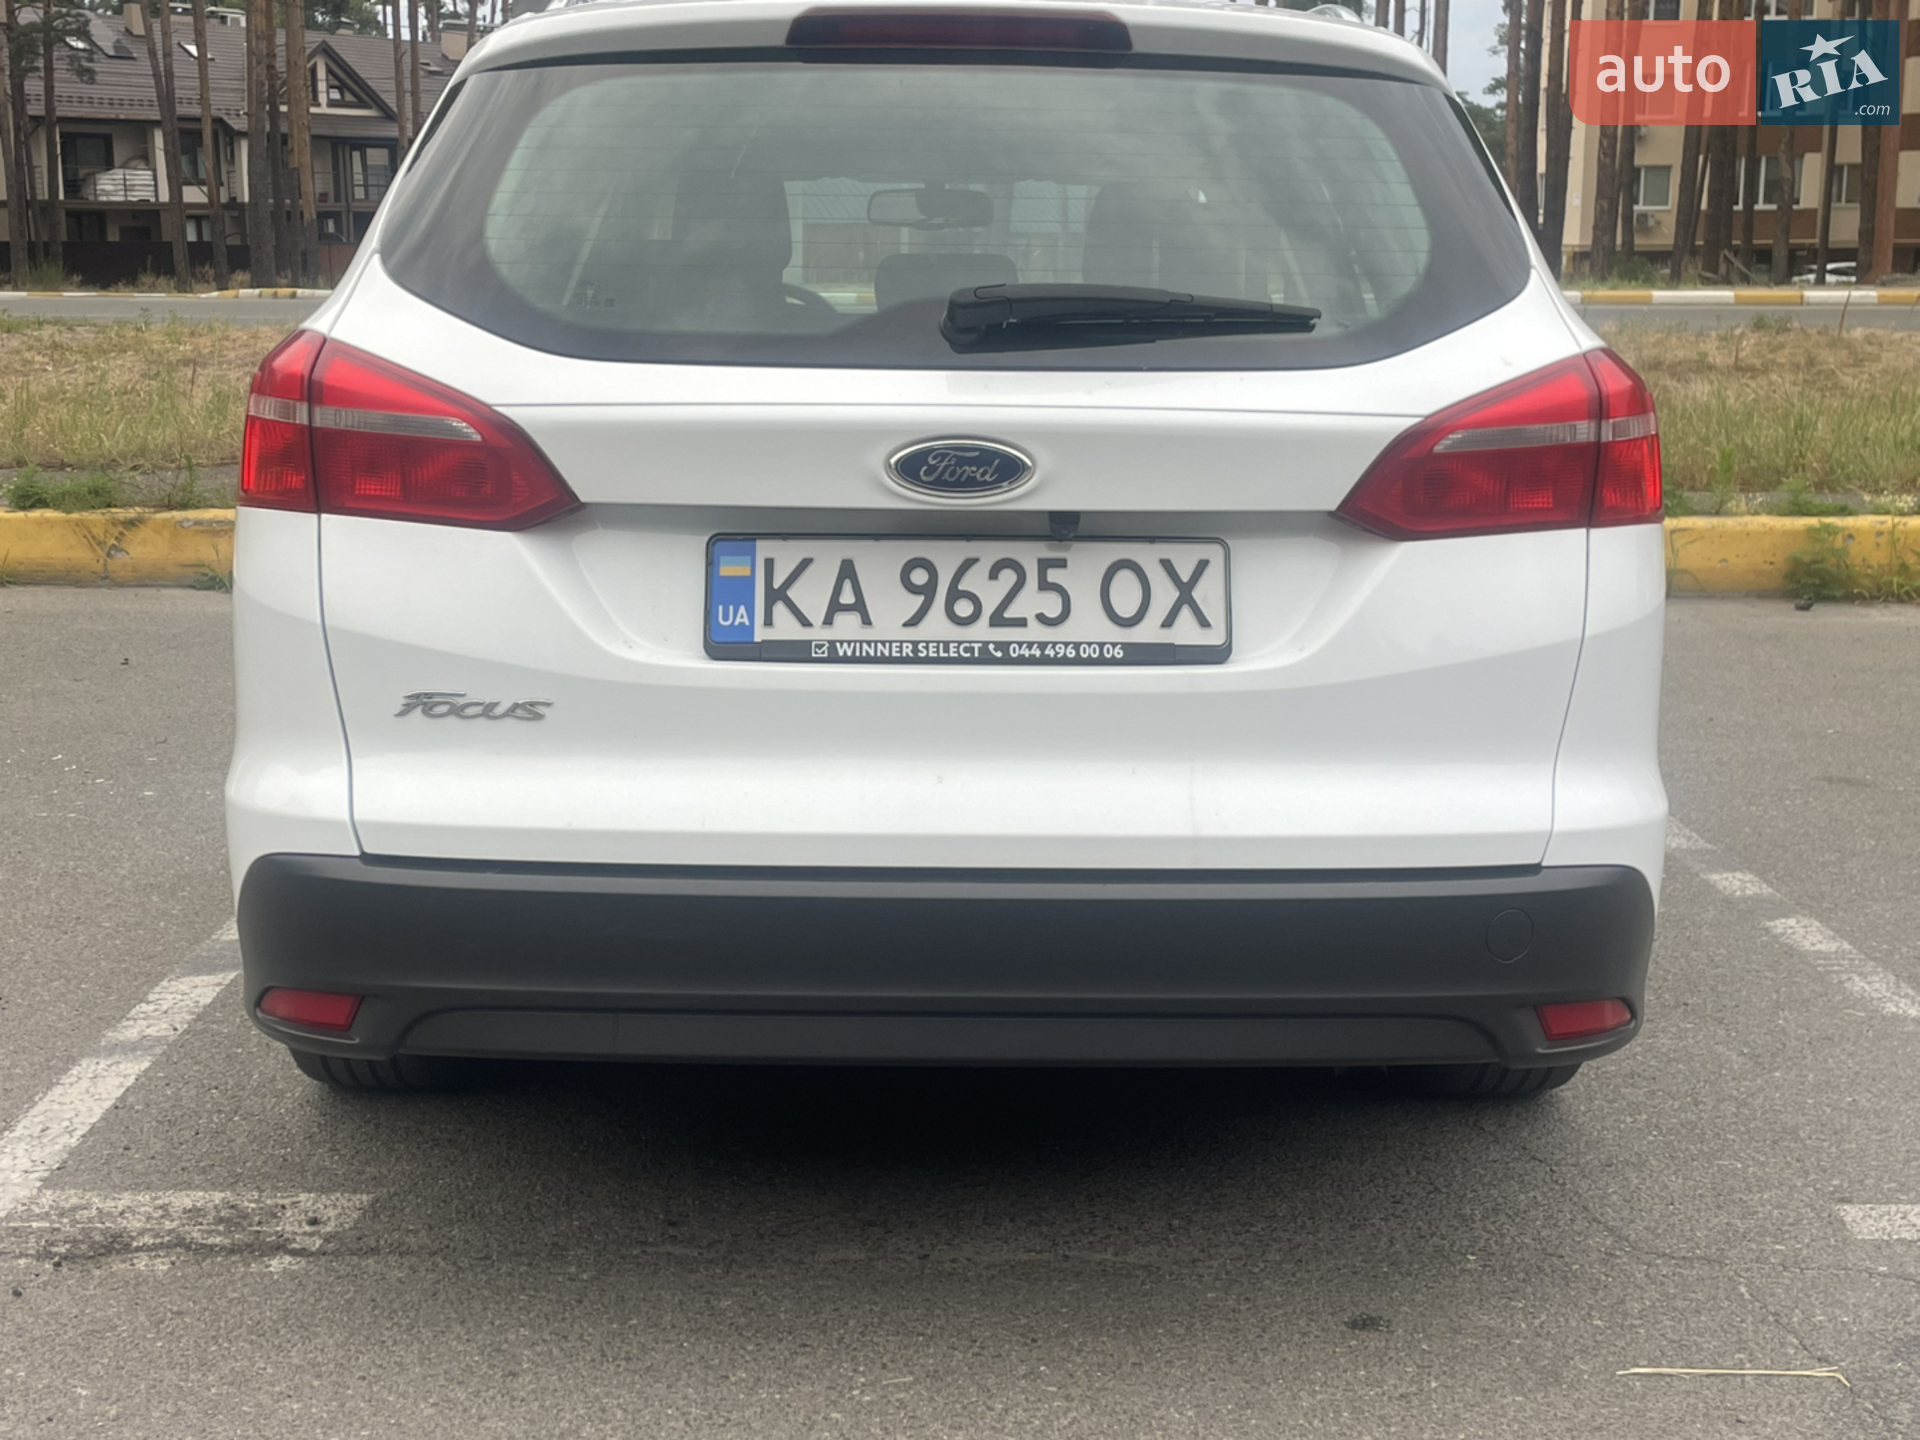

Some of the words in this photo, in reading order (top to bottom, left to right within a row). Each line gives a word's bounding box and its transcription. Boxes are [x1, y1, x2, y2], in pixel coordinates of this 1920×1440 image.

[919, 449, 1001, 482] Ford
[763, 557, 873, 628] KA
[899, 557, 1072, 628] 9625
[1099, 558, 1212, 629] OX
[718, 604, 750, 626] UA
[835, 641, 915, 658] WINNER
[917, 642, 983, 658] SELECT
[1008, 642, 1042, 658] 044
[1043, 642, 1077, 659] 496
[1079, 643, 1100, 659] 00
[1102, 643, 1125, 659] 06
